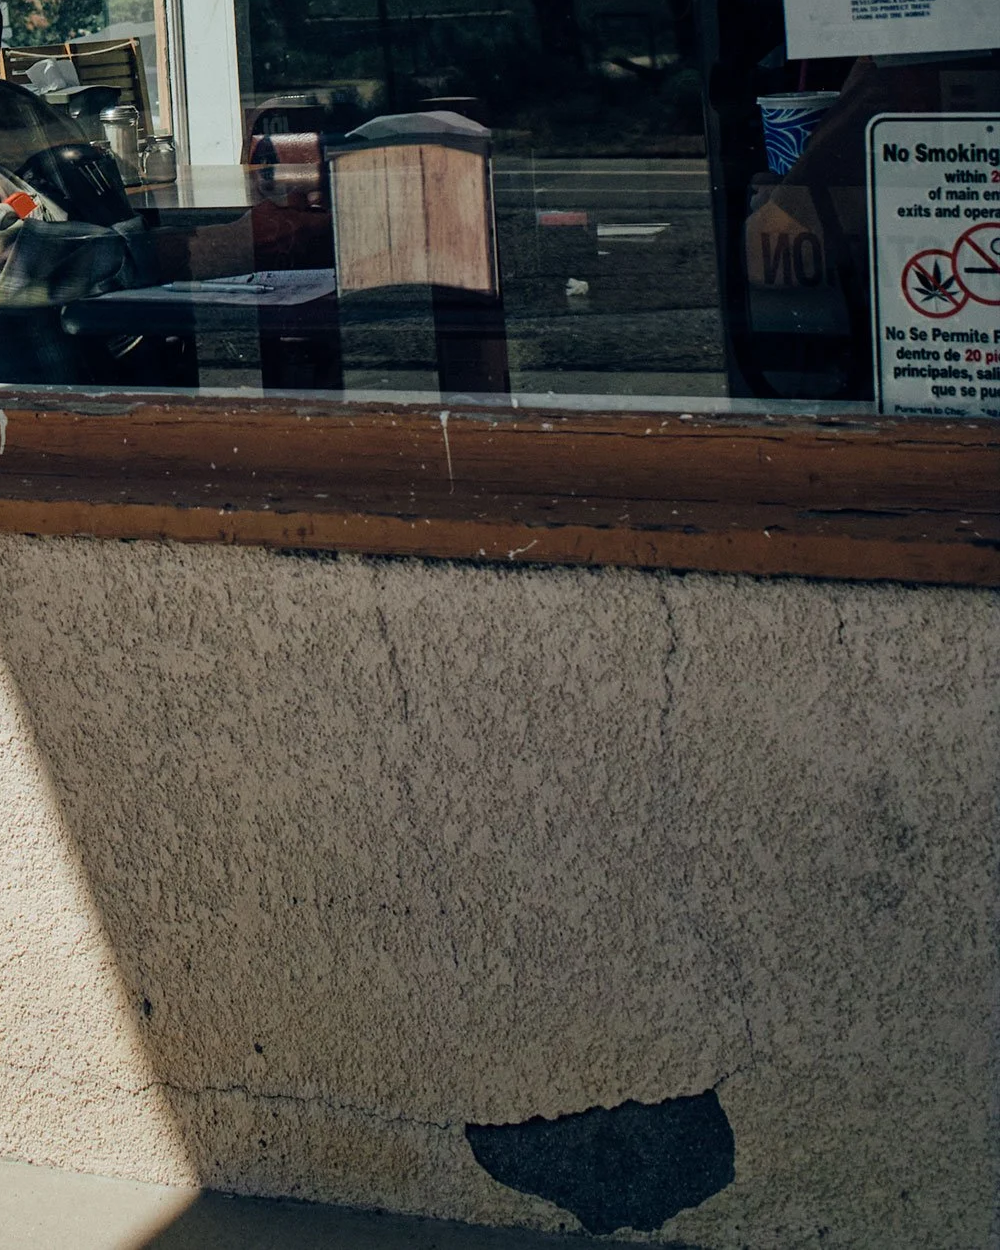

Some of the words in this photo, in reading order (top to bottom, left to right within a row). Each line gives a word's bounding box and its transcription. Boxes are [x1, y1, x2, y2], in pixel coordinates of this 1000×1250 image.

[883, 143, 910, 163] No
[915, 142, 1000, 167] Smoking
[944, 169, 988, 184] within
[991, 170, 1000, 184] 2
[928, 186, 941, 201] of
[945, 187, 980, 201] main
[897, 204, 931, 218] exits
[935, 204, 961, 218] and
[964, 207, 1000, 221] opera
[885, 326, 905, 341] No
[909, 327, 928, 341] Se
[932, 327, 989, 344] Permite
[896, 346, 940, 361] dentro
[944, 348, 961, 362] de
[965, 349, 982, 363] 20
[893, 363, 973, 382] principales,
[931, 385, 956, 398] que
[961, 385, 977, 397] se
